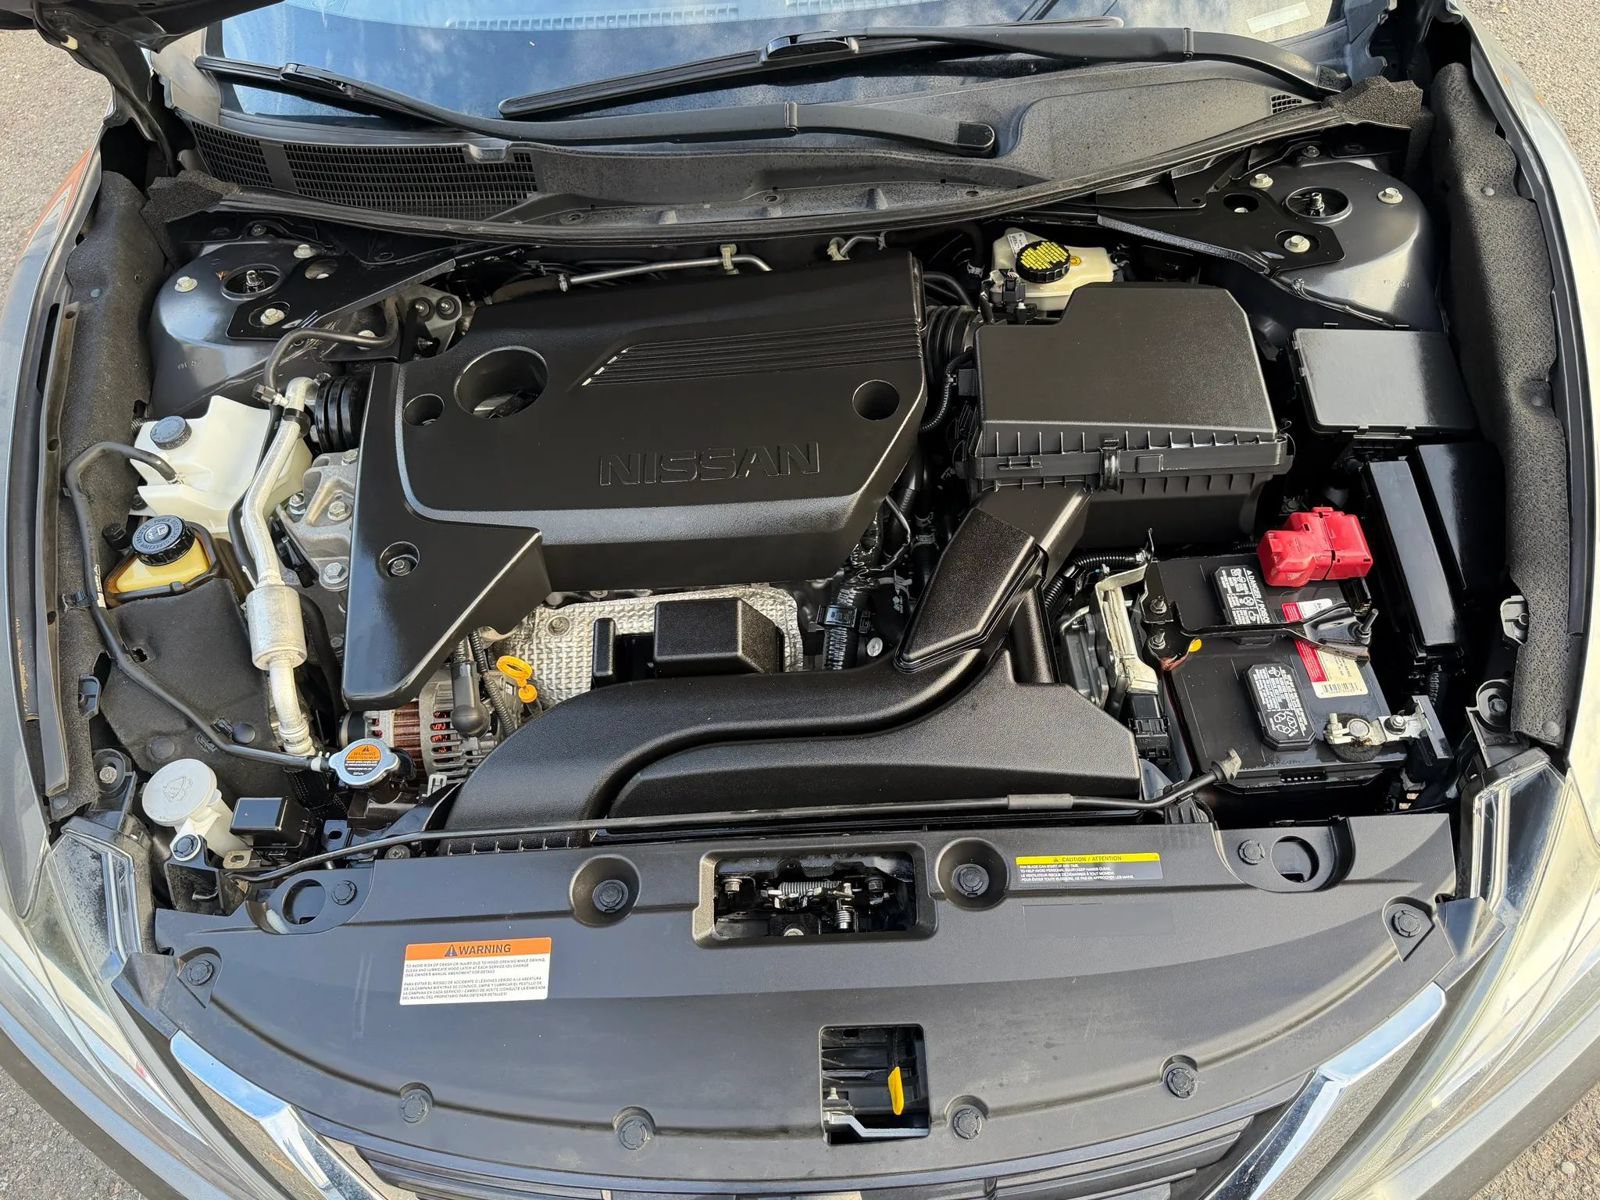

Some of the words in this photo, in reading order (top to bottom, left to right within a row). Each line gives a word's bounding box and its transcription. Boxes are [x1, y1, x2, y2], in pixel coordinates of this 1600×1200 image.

[599, 441, 819, 486] NISSAN
[1248, 575, 1262, 599] DANGER
[459, 944, 512, 955] WARNING
